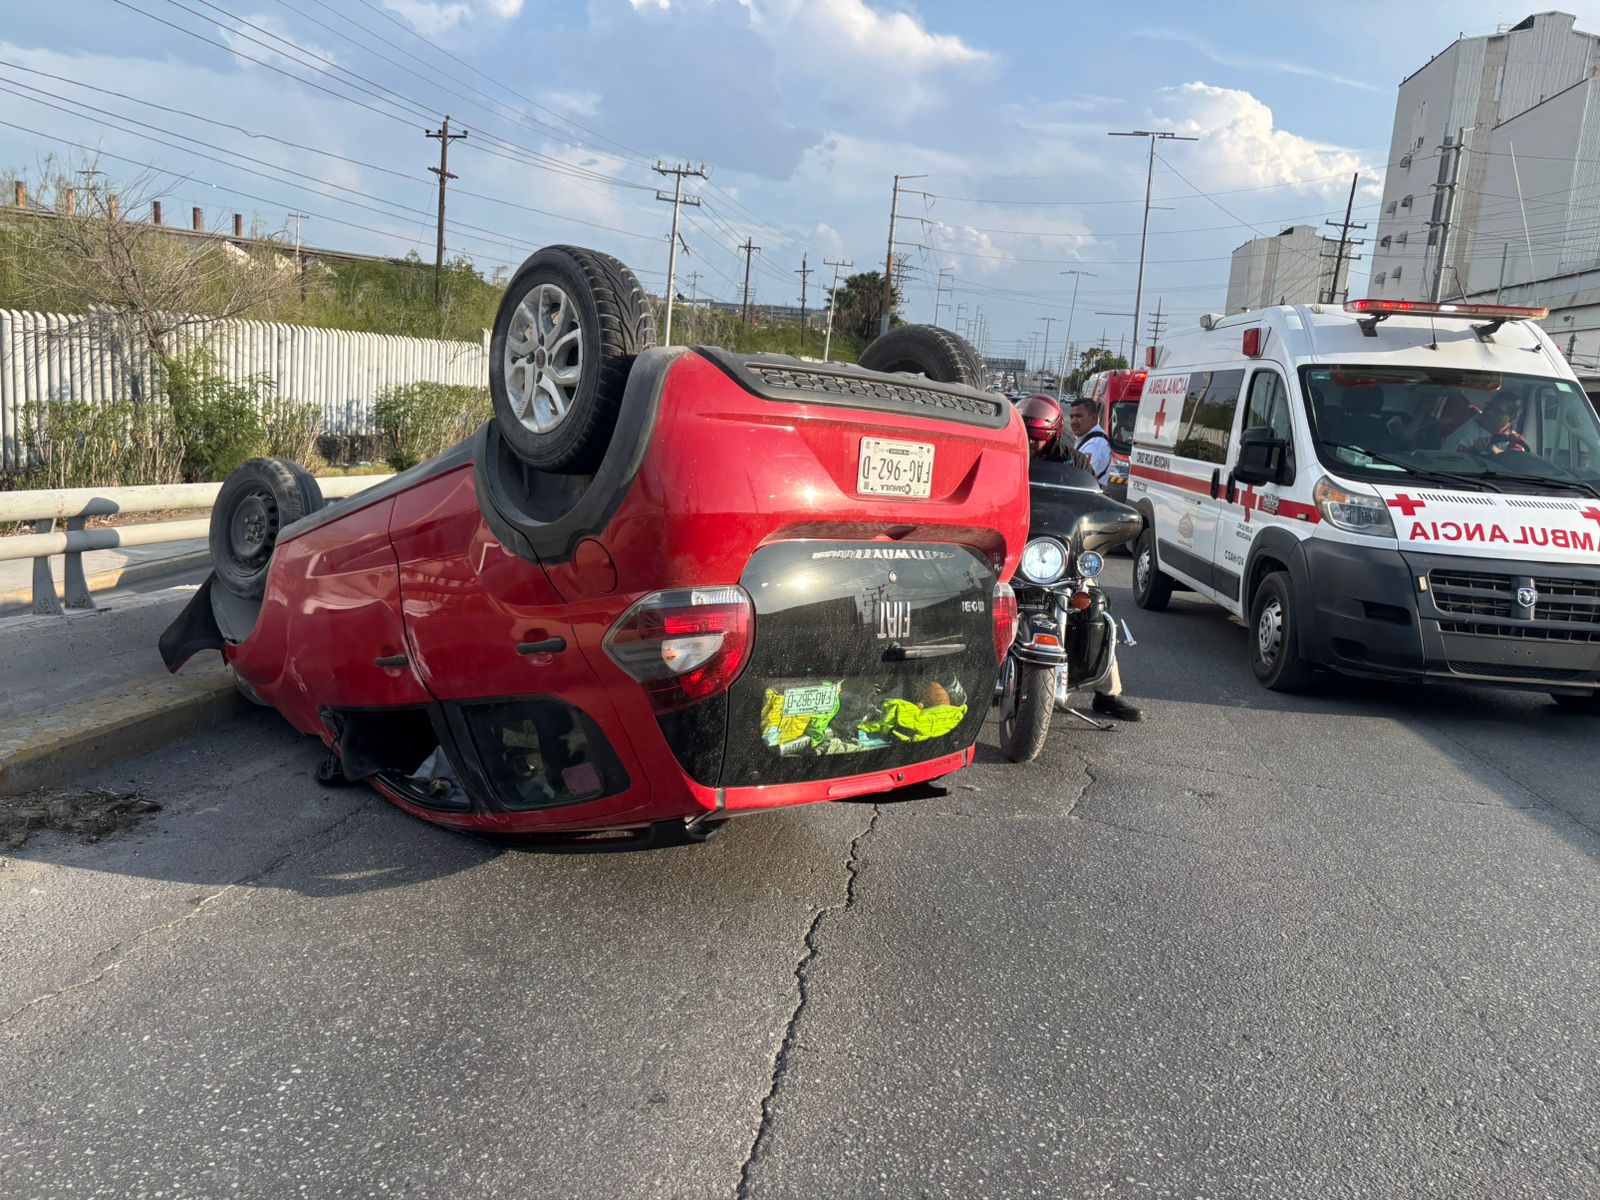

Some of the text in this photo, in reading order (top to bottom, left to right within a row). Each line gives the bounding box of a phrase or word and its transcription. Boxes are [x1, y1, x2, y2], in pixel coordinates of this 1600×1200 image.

[1148, 376, 1189, 395] AMBULANCIA
[862, 455, 931, 484] FAG-962-D
[961, 600, 985, 613] MOBI
[877, 601, 911, 639] FIAT
